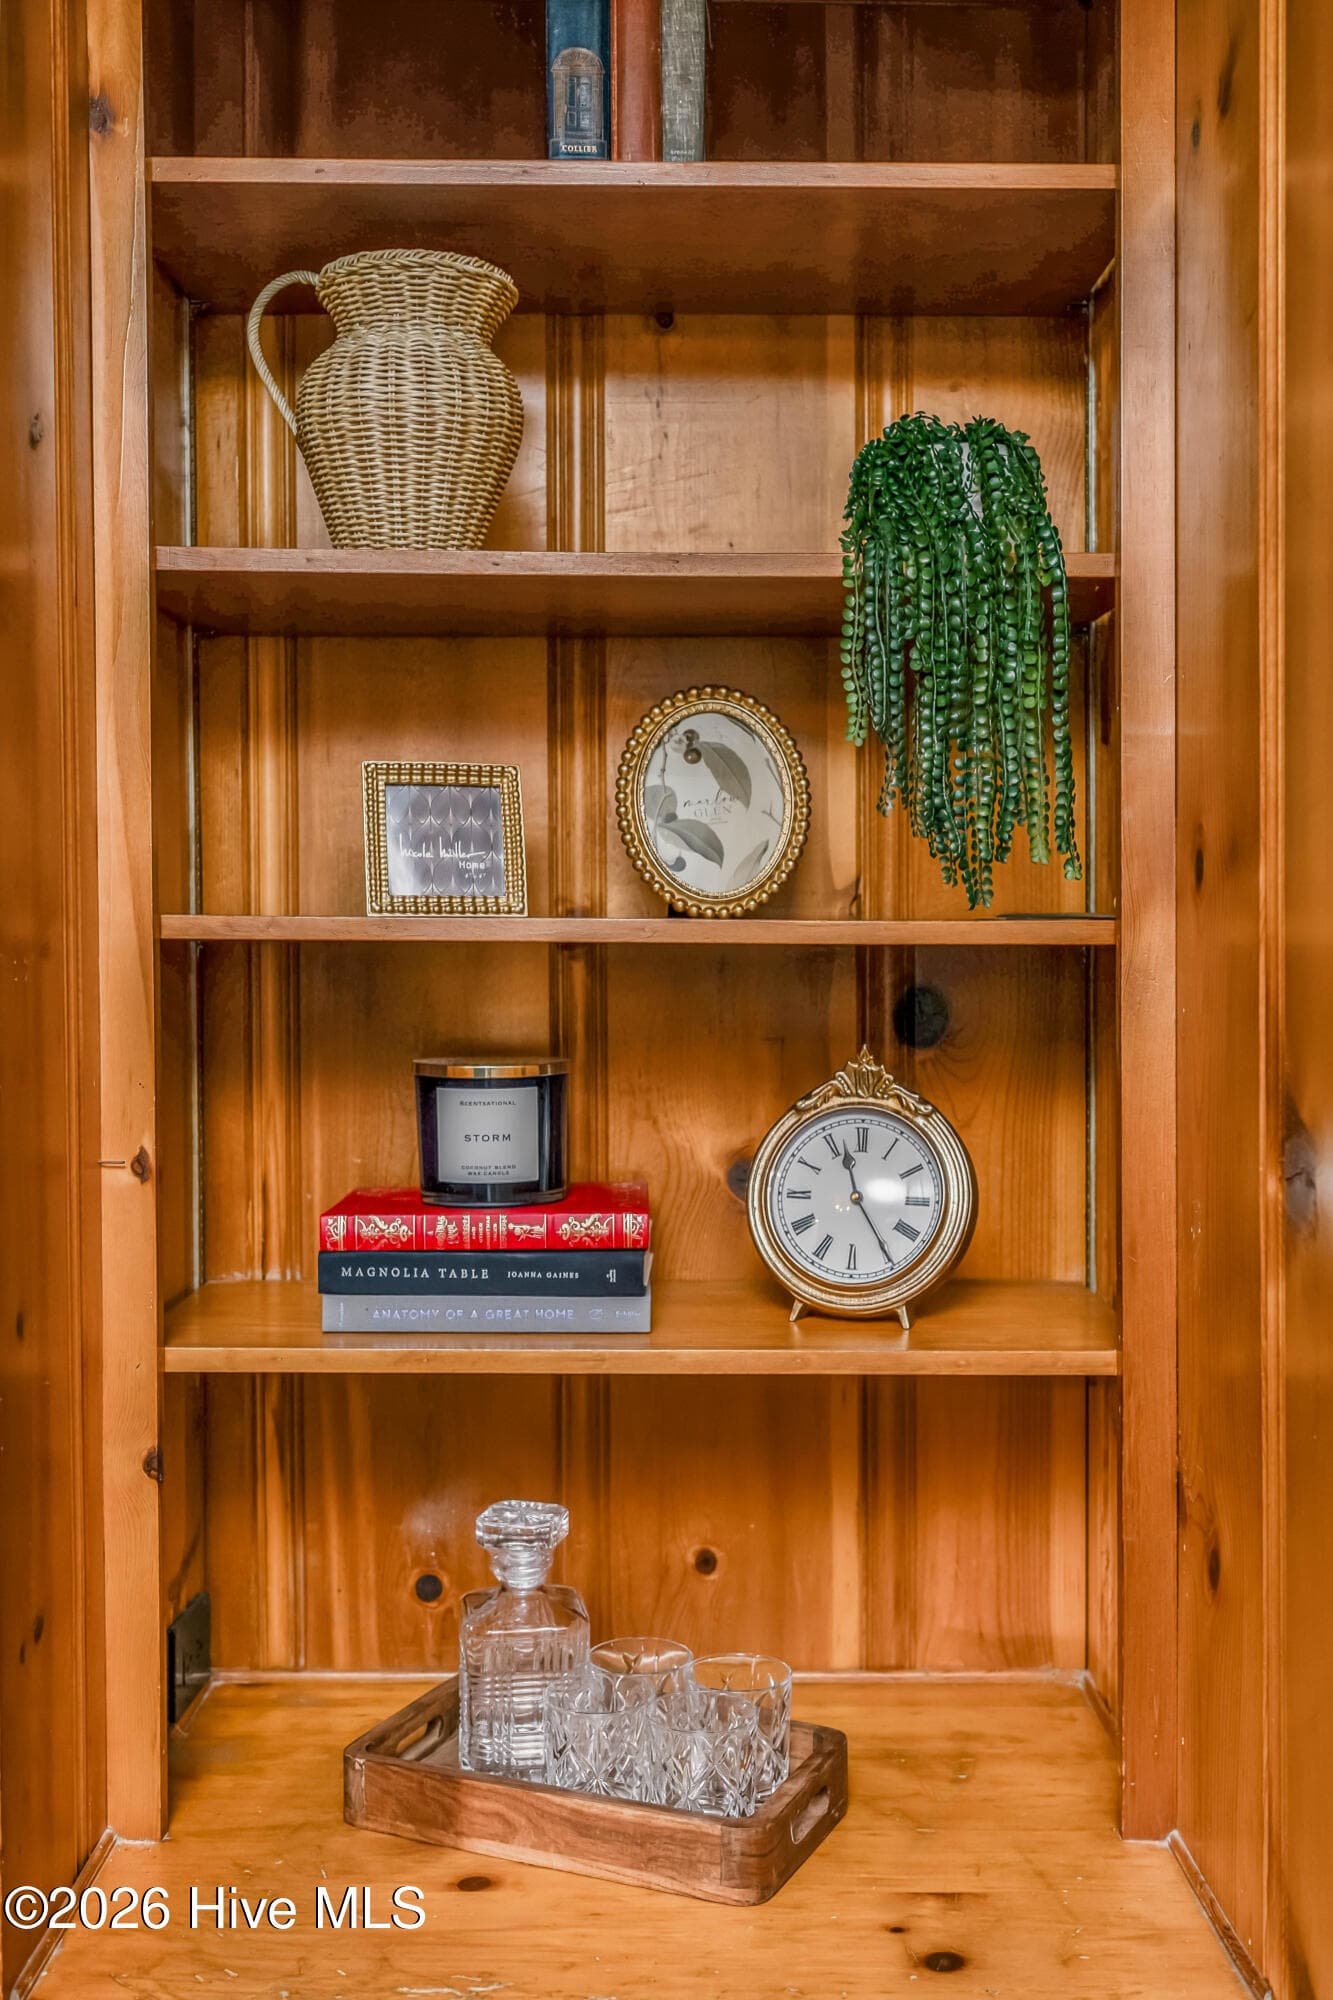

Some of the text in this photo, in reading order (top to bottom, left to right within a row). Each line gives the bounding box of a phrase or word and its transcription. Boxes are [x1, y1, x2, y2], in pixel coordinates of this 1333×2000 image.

[464, 1134, 511, 1143] STORM
[341, 1266, 580, 1280] MAGNOLIA TABLE JOANNA GAINES
[372, 1308, 575, 1320] ANATOMY OF A GREAT HOME
